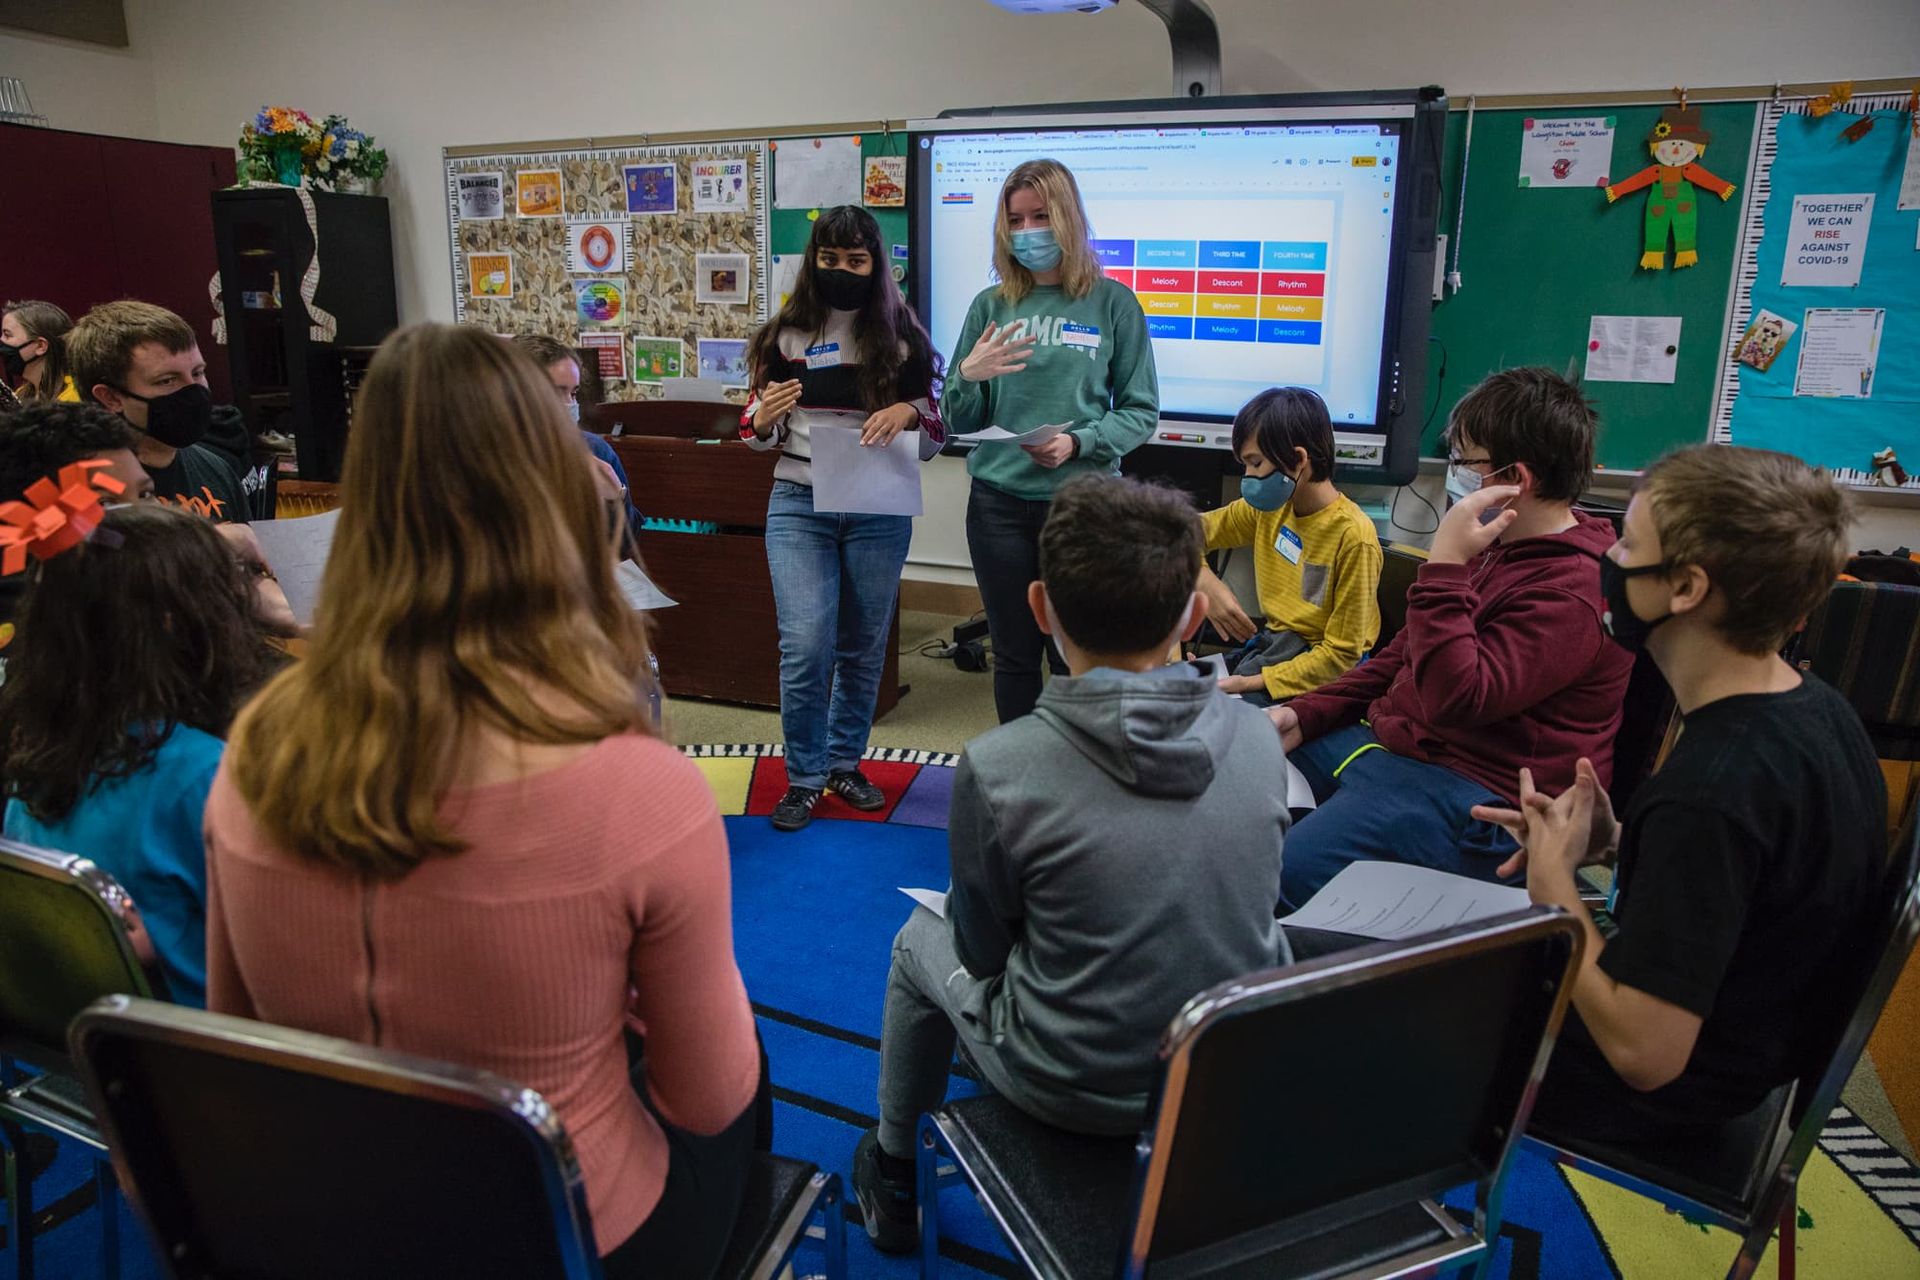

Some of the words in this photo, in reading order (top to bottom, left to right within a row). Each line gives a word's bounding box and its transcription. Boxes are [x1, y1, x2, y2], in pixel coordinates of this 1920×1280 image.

[696, 164, 742, 176] INQUIRER
[460, 178, 499, 190] BALANCED
[1802, 203, 1863, 213] TOGETHER
[1807, 217, 1825, 226] WE
[1828, 217, 1852, 226] CAN
[1814, 230, 1841, 239] RISE
[1800, 243, 1850, 252] AGAINST
[1274, 251, 1299, 259] FOURTH
[1798, 256, 1849, 265] COVID-19
[1152, 277, 1179, 286] Melody
[1212, 278, 1243, 287] Descant
[1278, 280, 1307, 289] Rhythm
[1150, 300, 1179, 308] Descant
[1213, 302, 1241, 312] Rhythm
[1277, 304, 1305, 313] Melody
[1150, 323, 1176, 332] Rhythm
[1212, 326, 1239, 335] Melody
[1274, 327, 1305, 336] Descant
